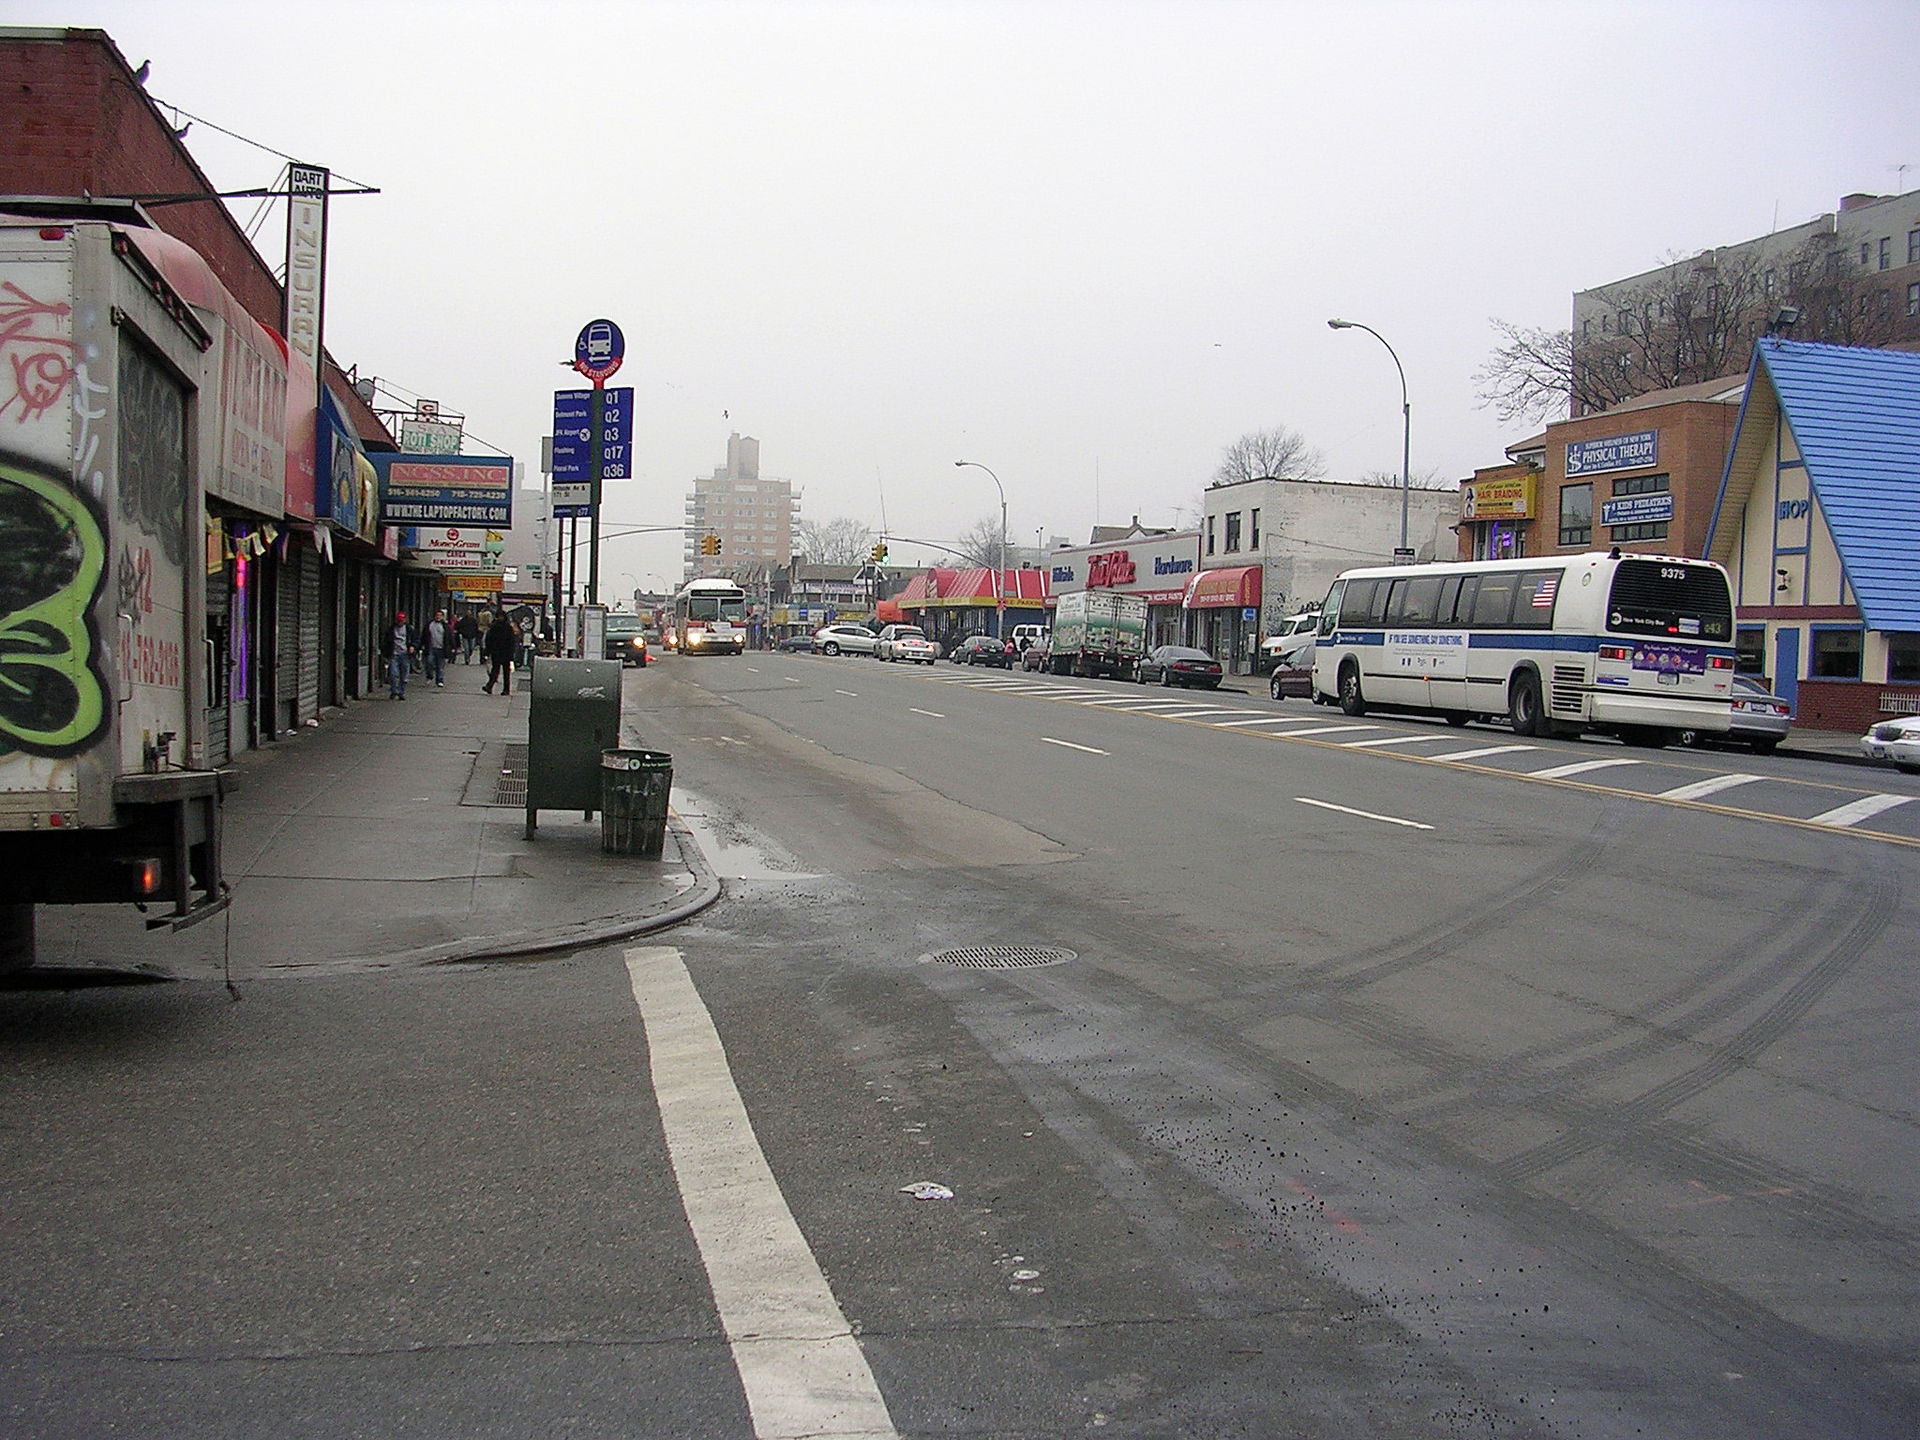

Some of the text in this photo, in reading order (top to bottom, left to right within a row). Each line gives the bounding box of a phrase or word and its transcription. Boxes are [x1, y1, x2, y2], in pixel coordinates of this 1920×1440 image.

[294, 170, 322, 186] DART
[294, 186, 323, 201] AUTO
[292, 207, 318, 358] INSURAN
[587, 361, 619, 378] STANDING
[574, 392, 591, 400] Village
[606, 391, 619, 405] Q1
[604, 409, 620, 423] Q2
[403, 431, 459, 450] ROTI SHOP
[604, 428, 619, 442] Q3
[554, 447, 575, 455] Flushing
[604, 446, 624, 460] Q17
[1583, 447, 1617, 464] PHYSICAL
[1620, 442, 1655, 459] THERAPY
[603, 464, 624, 478] Q36
[1477, 488, 1523, 499] HAIR BRAIDING
[1616, 500, 1633, 511] KIDS
[429, 539, 481, 549] MoneyGram
[1154, 555, 1193, 575] Hardware
[1660, 567, 1686, 580] 9375
[1645, 618, 1655, 626] City
